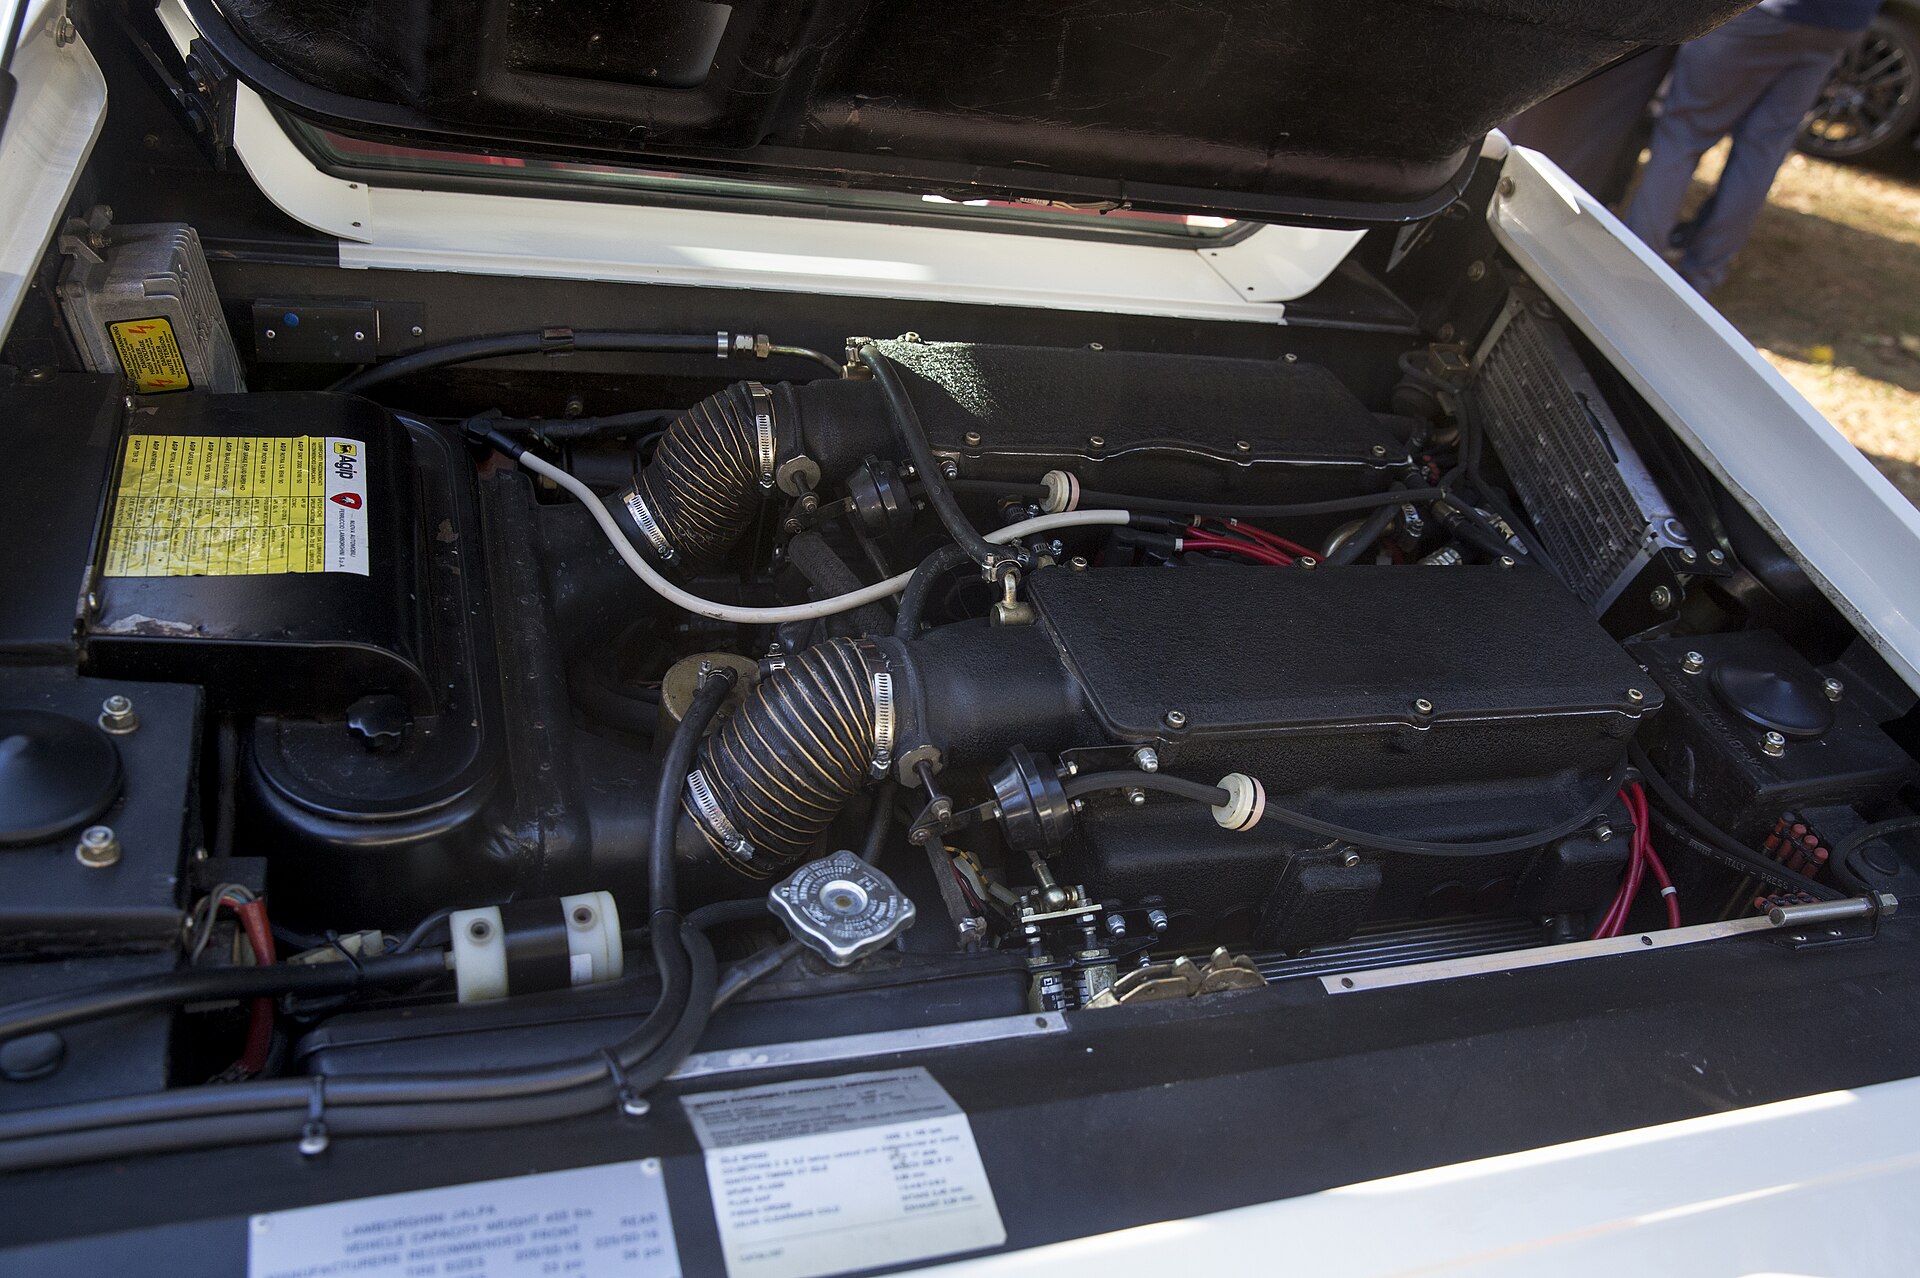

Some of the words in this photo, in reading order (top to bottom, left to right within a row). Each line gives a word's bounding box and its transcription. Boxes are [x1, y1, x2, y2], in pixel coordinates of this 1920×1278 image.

[138, 340, 150, 361] VOLTAGE
[155, 345, 167, 366] DANGER
[158, 335, 169, 357] TENSION
[136, 348, 147, 368] DANGER
[146, 362, 155, 374] HIGH
[165, 359, 176, 375] HAUTE
[186, 452, 194, 464] GREASE
[334, 455, 357, 479] Agip
[337, 508, 345, 528] FERRUCCIO
[337, 530, 345, 555] LAMBORGHINI
[1761, 872, 1789, 891] PRESS
